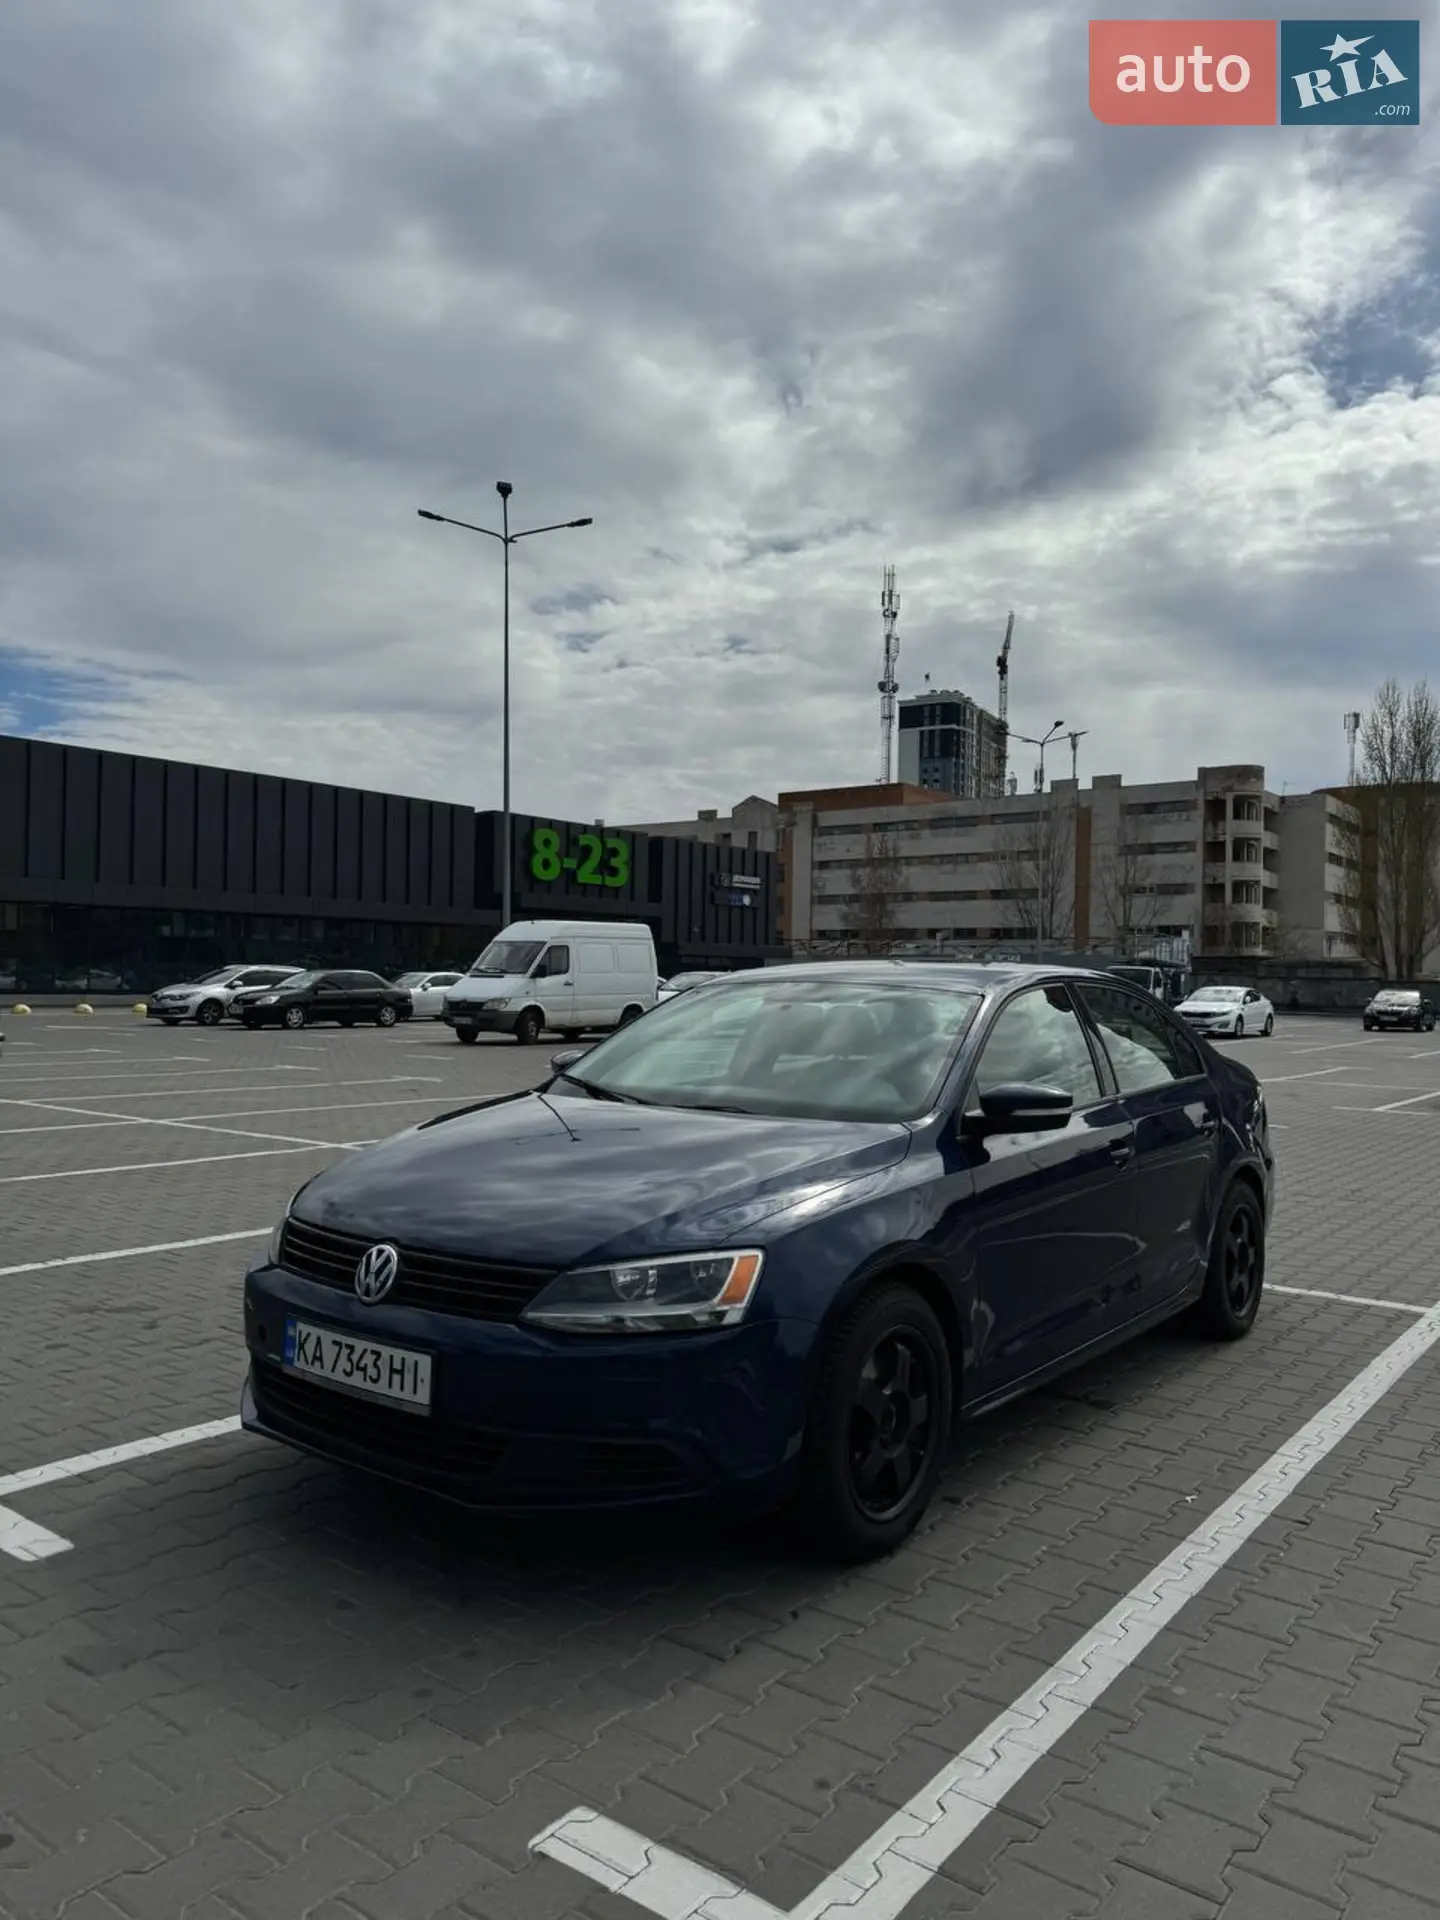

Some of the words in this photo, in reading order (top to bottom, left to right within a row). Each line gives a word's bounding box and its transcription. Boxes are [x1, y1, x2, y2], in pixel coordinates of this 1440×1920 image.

[531, 828, 630, 887] 8-23
[297, 1329, 324, 1370] KA
[331, 1340, 382, 1385] 7343
[387, 1354, 418, 1396] HI
